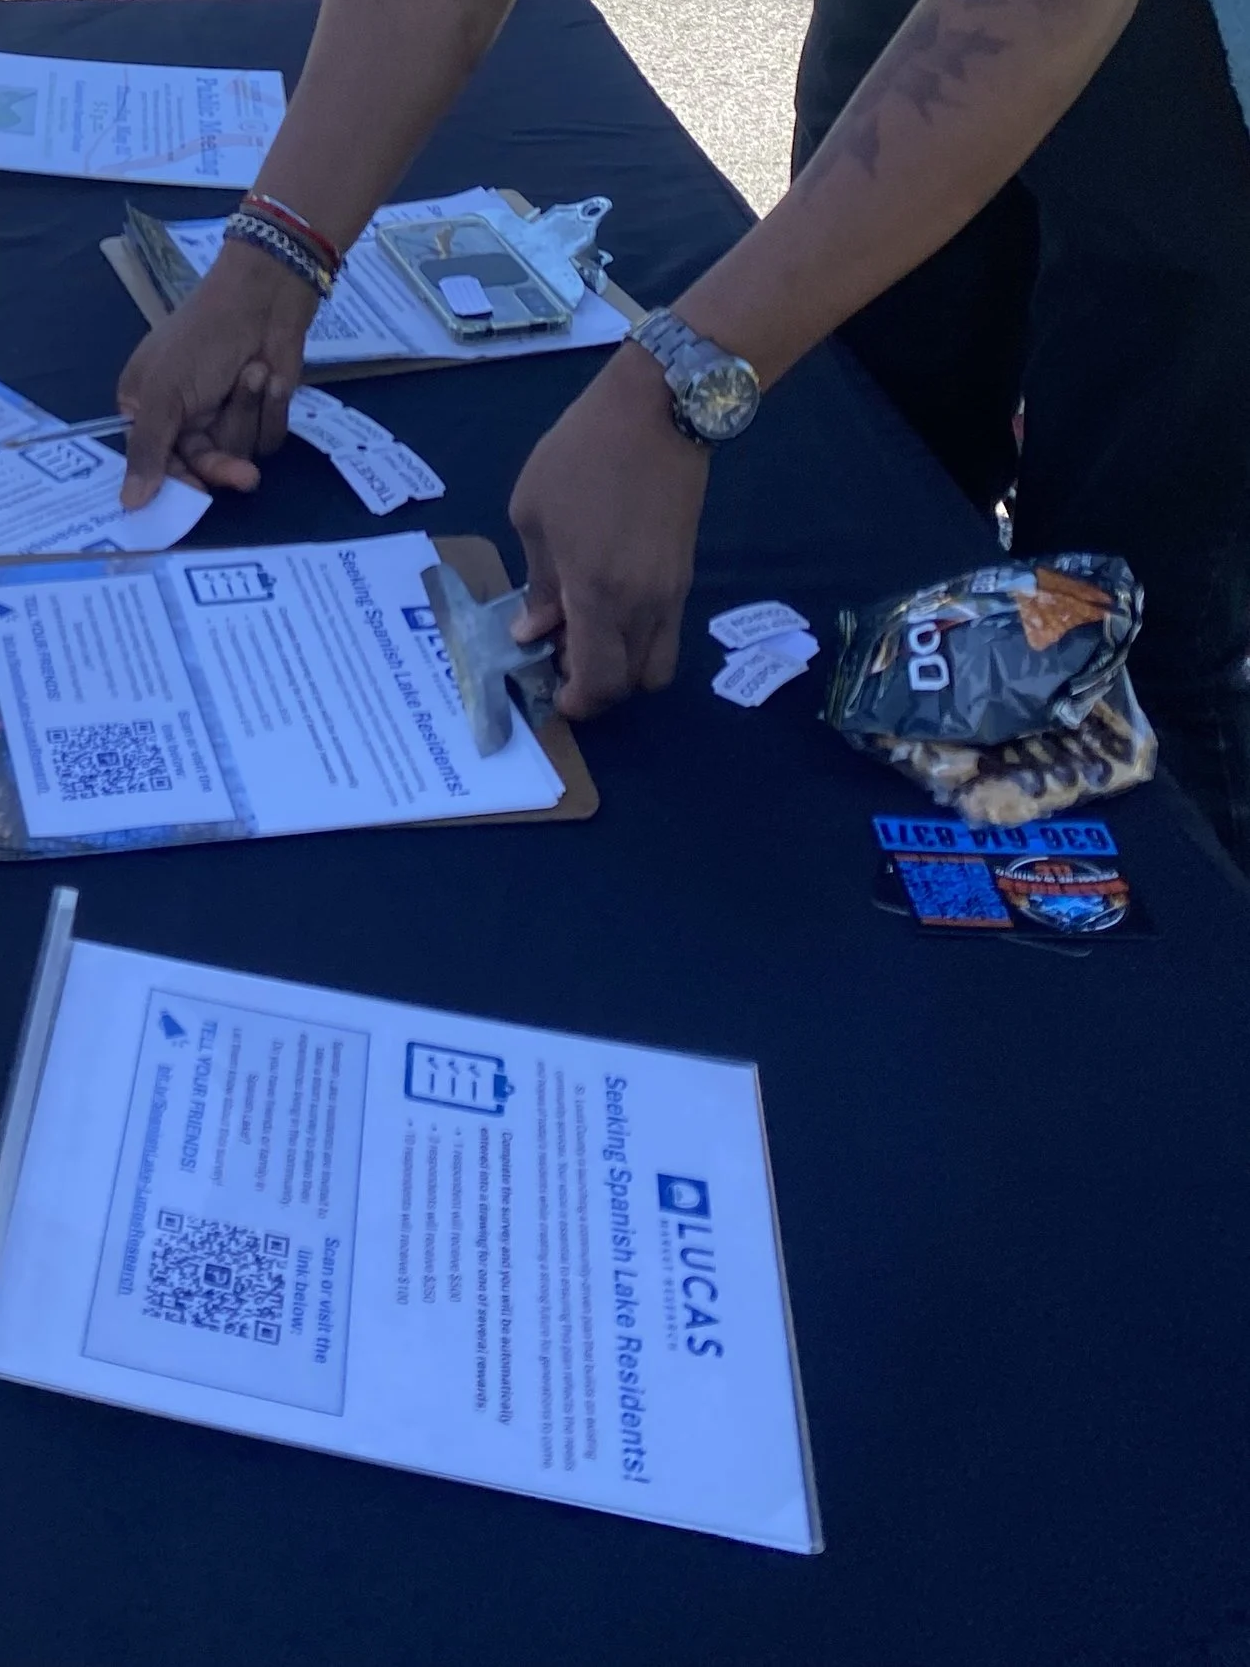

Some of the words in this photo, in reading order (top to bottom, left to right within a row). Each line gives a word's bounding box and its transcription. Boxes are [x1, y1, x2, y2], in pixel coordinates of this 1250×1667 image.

[198, 76, 226, 118] Public
[196, 117, 226, 176] Meeting
[350, 458, 395, 507] TICKET
[332, 549, 380, 607] Seeking
[359, 608, 409, 671] Spanish
[390, 671, 428, 709] Lake
[409, 710, 473, 798] Residents!
[196, 1019, 217, 1054] TELL
[190, 1054, 212, 1098] YOUR
[178, 1098, 206, 1175] FRIENDS!
[598, 1074, 632, 1165] Seeking
[603, 1165, 638, 1266] Spanish
[294, 1246, 312, 1279] link
[320, 1236, 339, 1278] Scan
[319, 1278, 336, 1298] or
[613, 1268, 642, 1331] Lake
[675, 1220, 725, 1362] LUCAS
[316, 1297, 335, 1335] visit
[313, 1335, 332, 1366] the
[616, 1333, 651, 1487] Residents!
